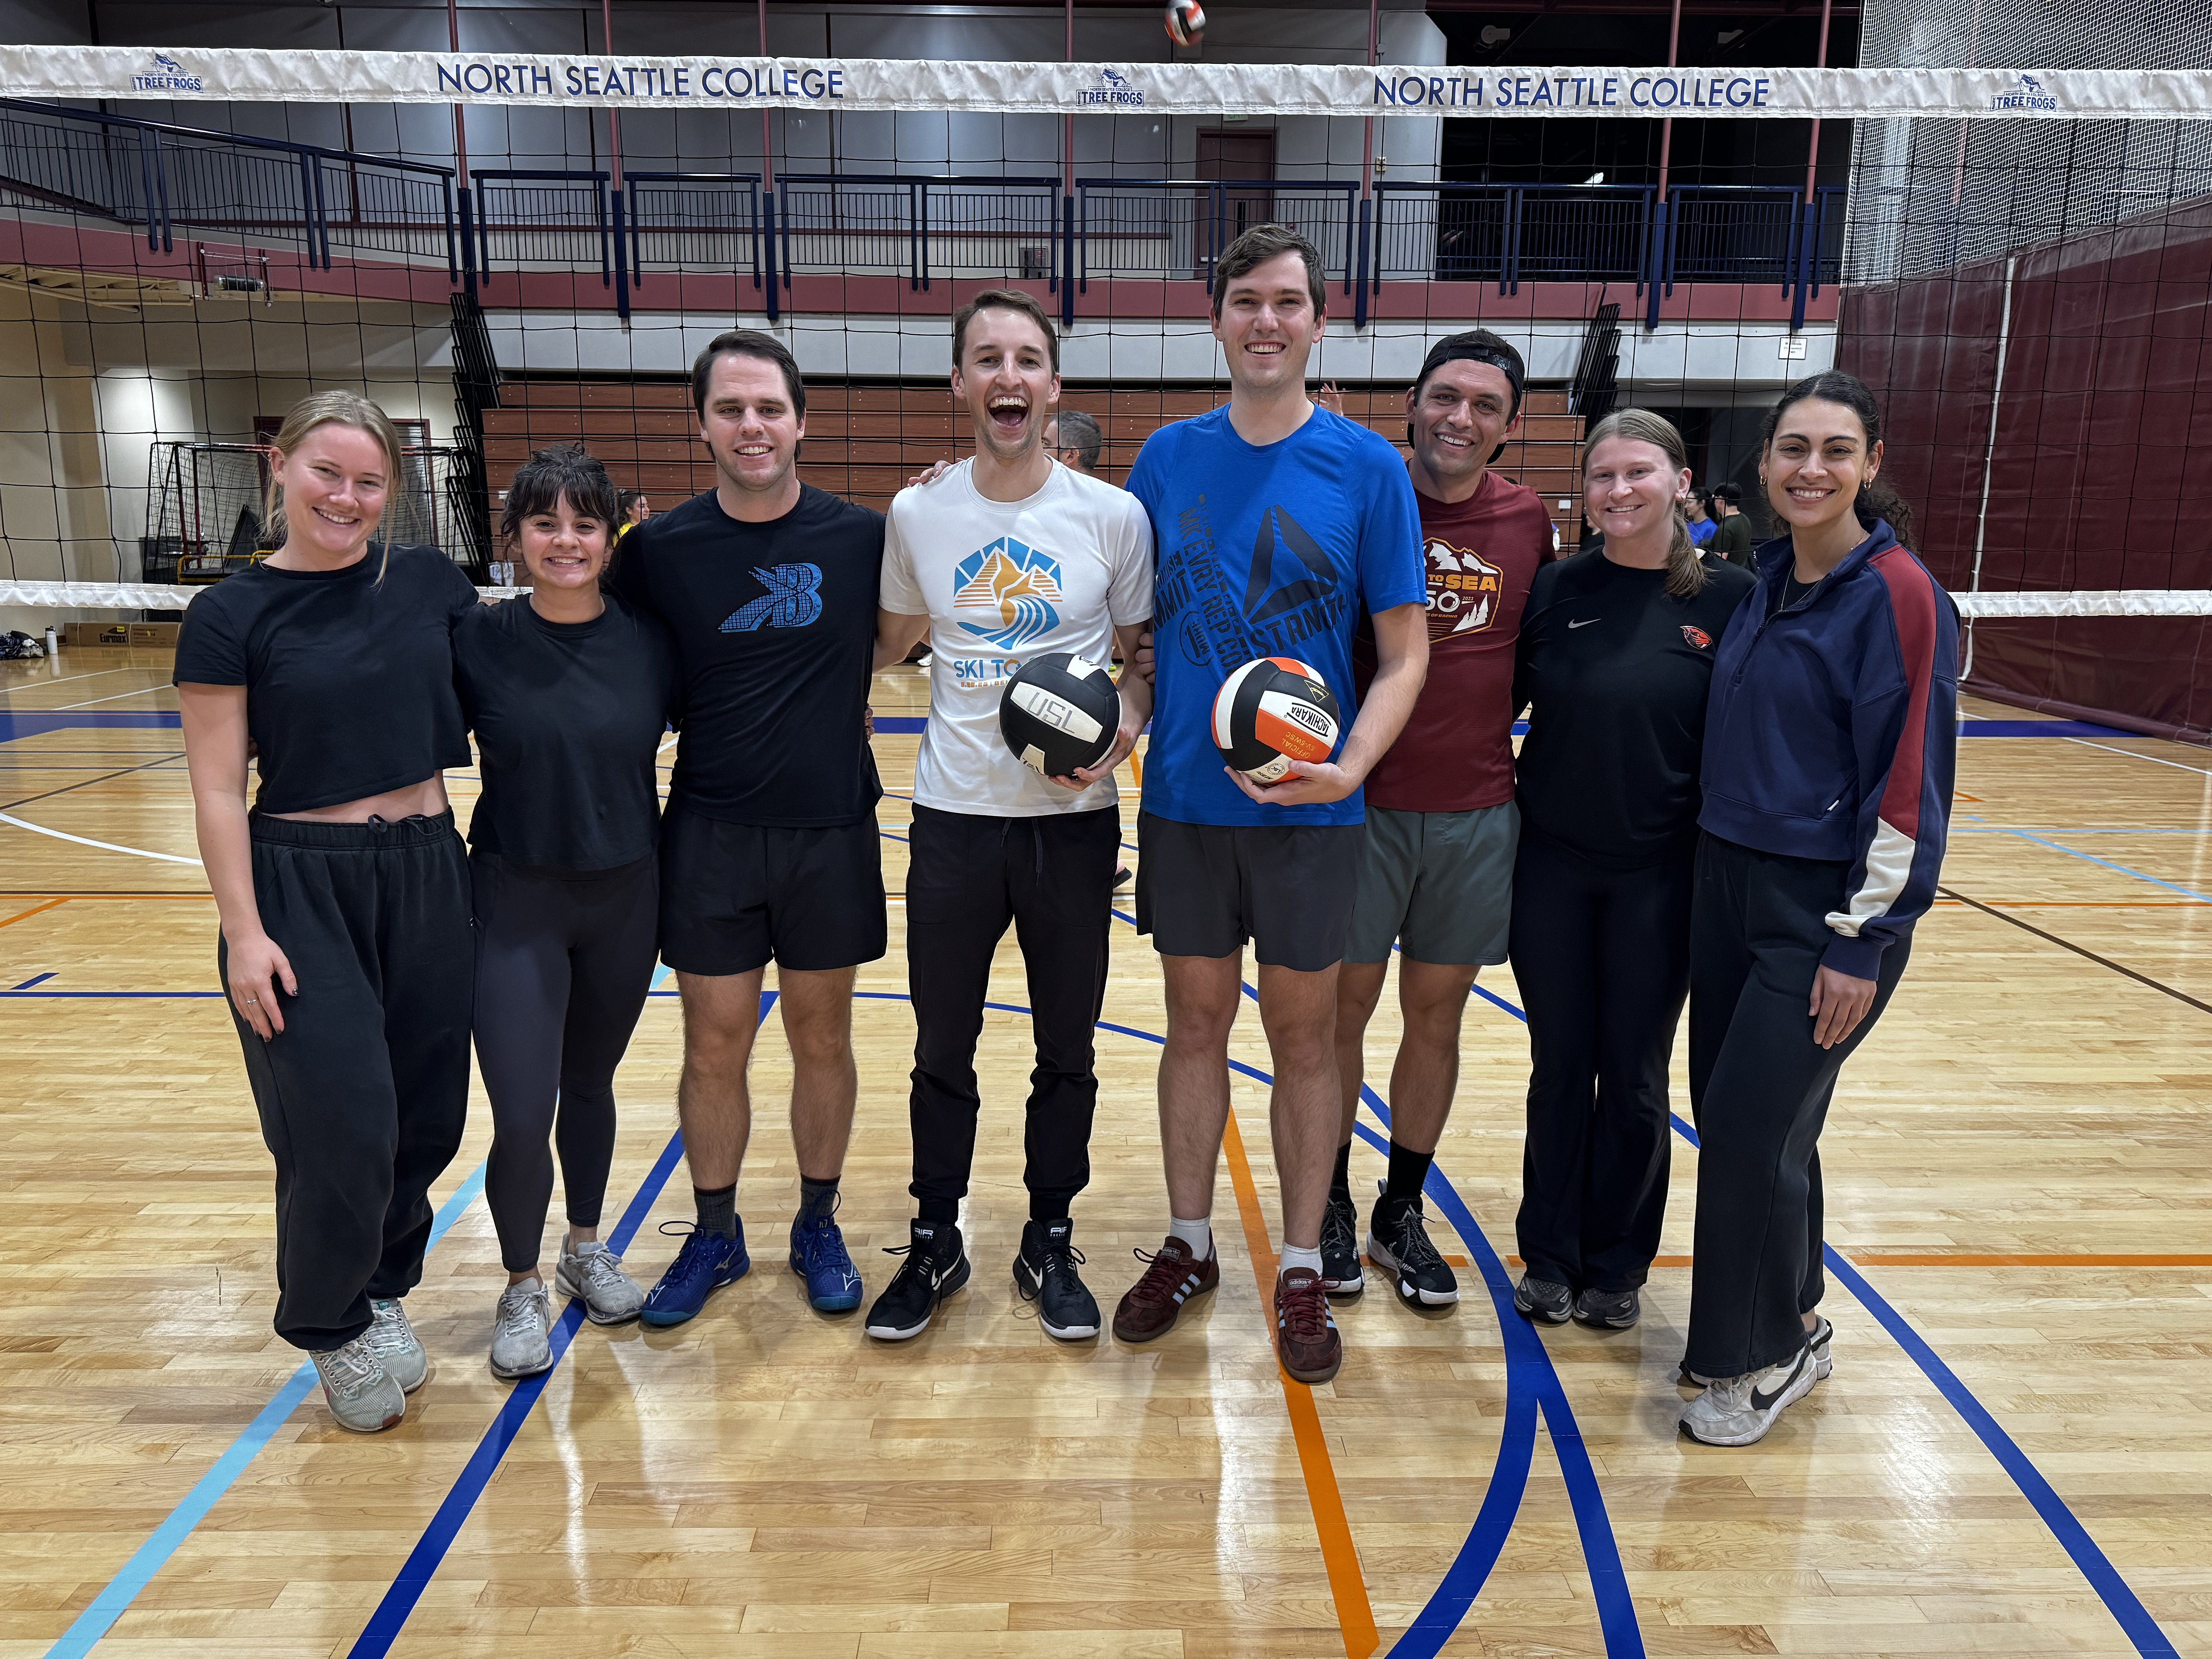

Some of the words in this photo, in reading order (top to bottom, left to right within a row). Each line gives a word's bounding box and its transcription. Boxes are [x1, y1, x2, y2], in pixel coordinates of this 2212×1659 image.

[136, 77, 165, 89] TREE
[166, 77, 201, 91] FROGS
[438, 63, 552, 94] NORTH
[567, 66, 689, 96] SEATTLE
[702, 67, 843, 99] COLLEGE
[1373, 74, 1483, 106] NORTH
[1495, 76, 1618, 106] SEATTLE
[1630, 77, 1770, 107] COLLEGE
[1082, 91, 1108, 103] TREE
[1110, 91, 1142, 105] FROGS
[1997, 96, 2025, 109] TREE
[2026, 97, 2056, 110] FROGS
[1178, 505, 1202, 541] MK
[1183, 538, 1218, 593] EVRY
[1428, 574, 1444, 582] TO
[1445, 574, 1497, 591] SEA
[1425, 590, 1460, 613] 50
[1201, 594, 1231, 633] REP
[100, 633, 127, 643] Eurmax
[1191, 618, 1211, 655] MORE
[953, 659, 984, 678] SKI
[1026, 692, 1075, 734] USL
[1287, 706, 1330, 737] TACHIKARA
[1282, 738, 1310, 758] OFFICIAL
[1285, 731, 1315, 751] SV-5WSC
[914, 1227, 934, 1236] AIR
